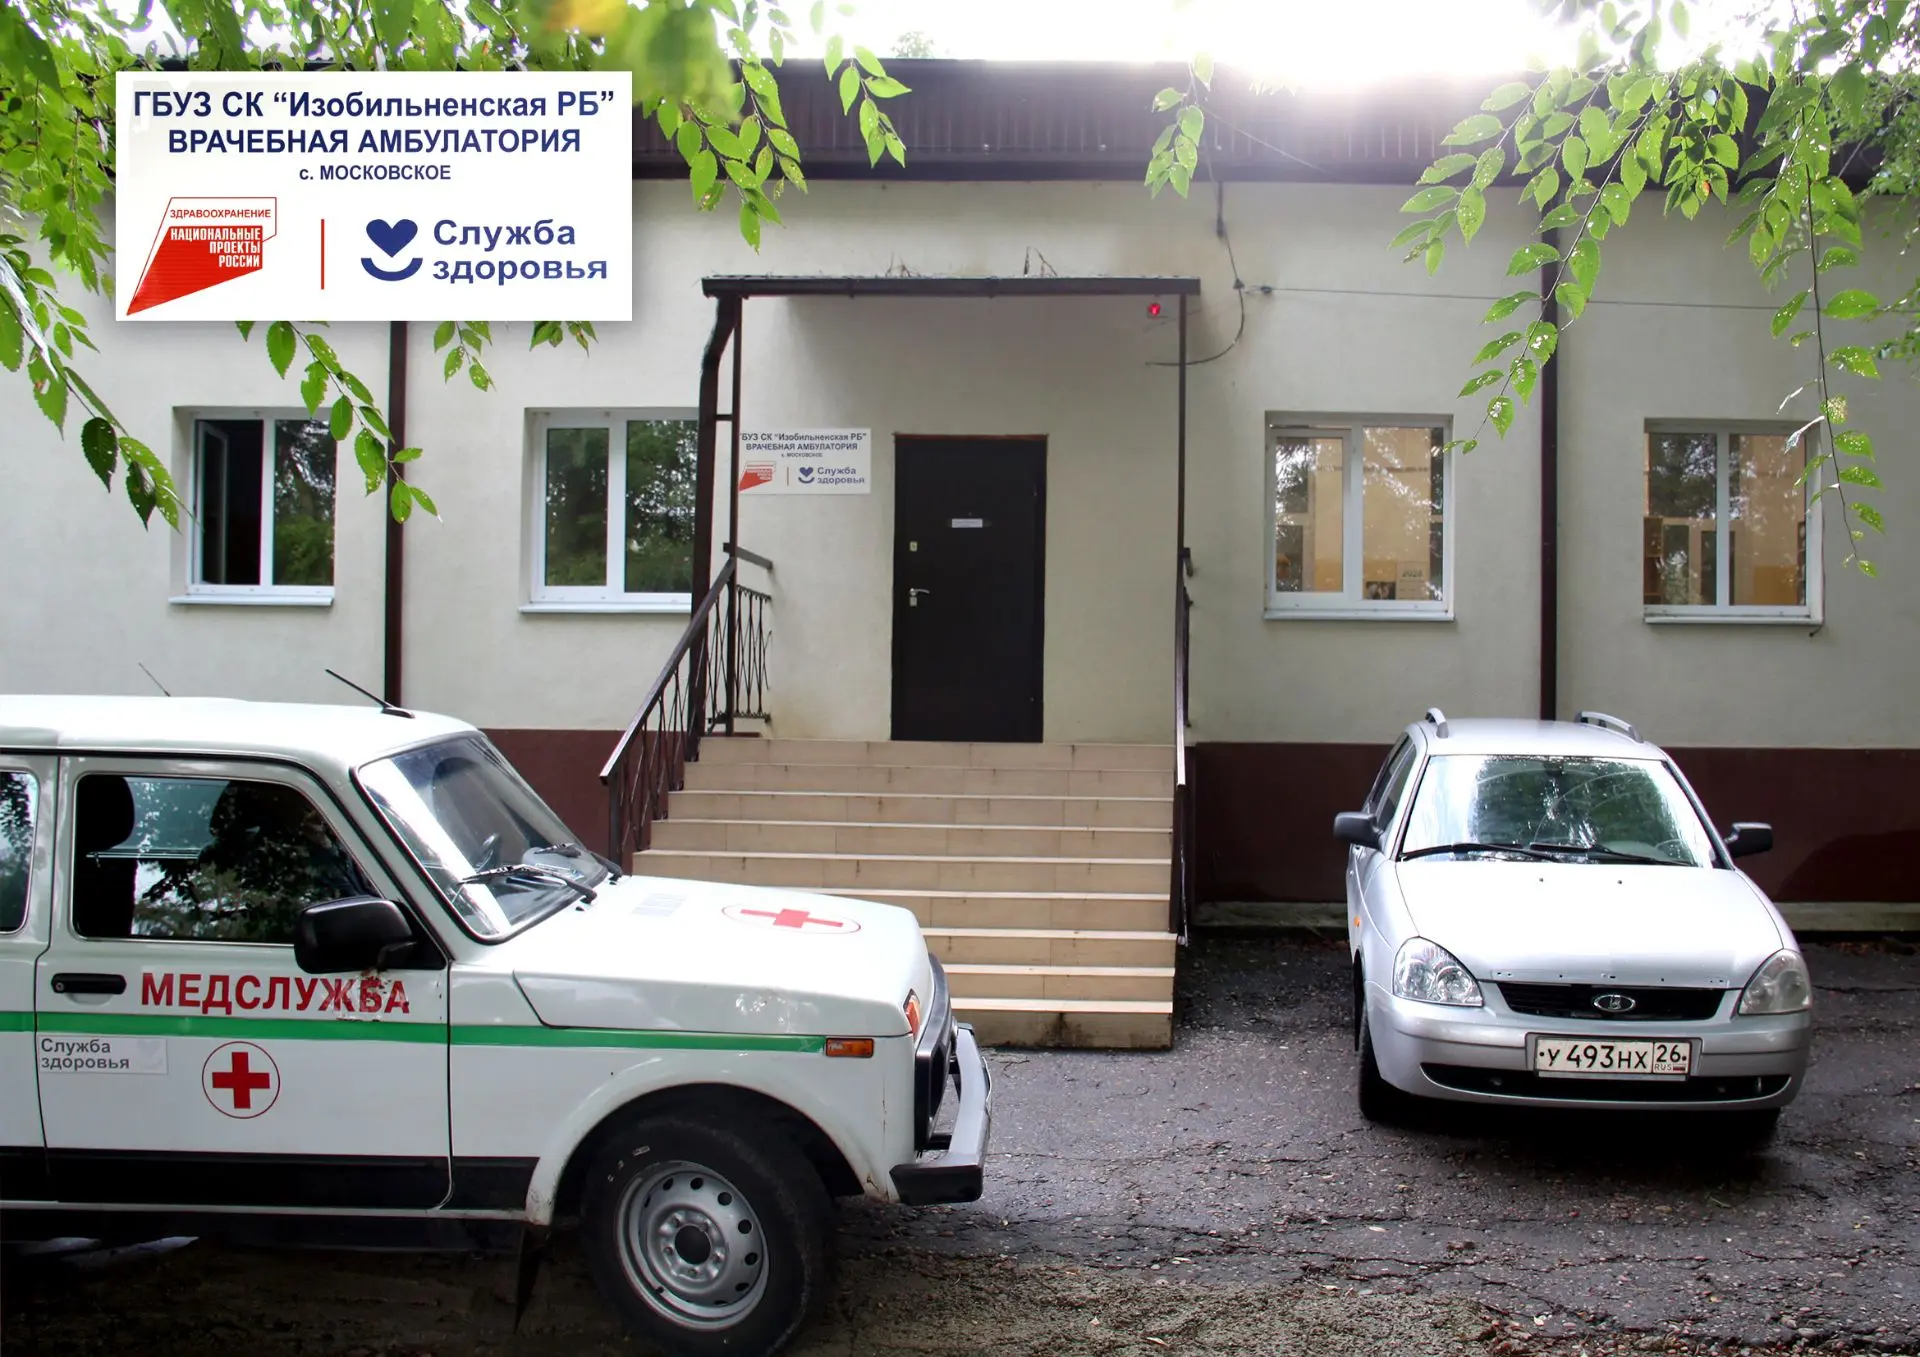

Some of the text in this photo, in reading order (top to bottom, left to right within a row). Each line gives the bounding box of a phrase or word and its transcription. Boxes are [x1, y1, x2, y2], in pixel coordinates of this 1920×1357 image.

[760, 433, 773, 441] СК
[746, 442, 858, 451] ВРАЧЕБНАЯ АМБУЛАТОРИЯ
[817, 466, 857, 477] Служба
[817, 476, 865, 486] здоровья
[141, 972, 411, 1015] МЕДСЛУЖБА
[41, 1038, 112, 1056] Служба
[41, 1055, 130, 1071] здоровья
[1654, 1063, 1672, 1072] RUS
